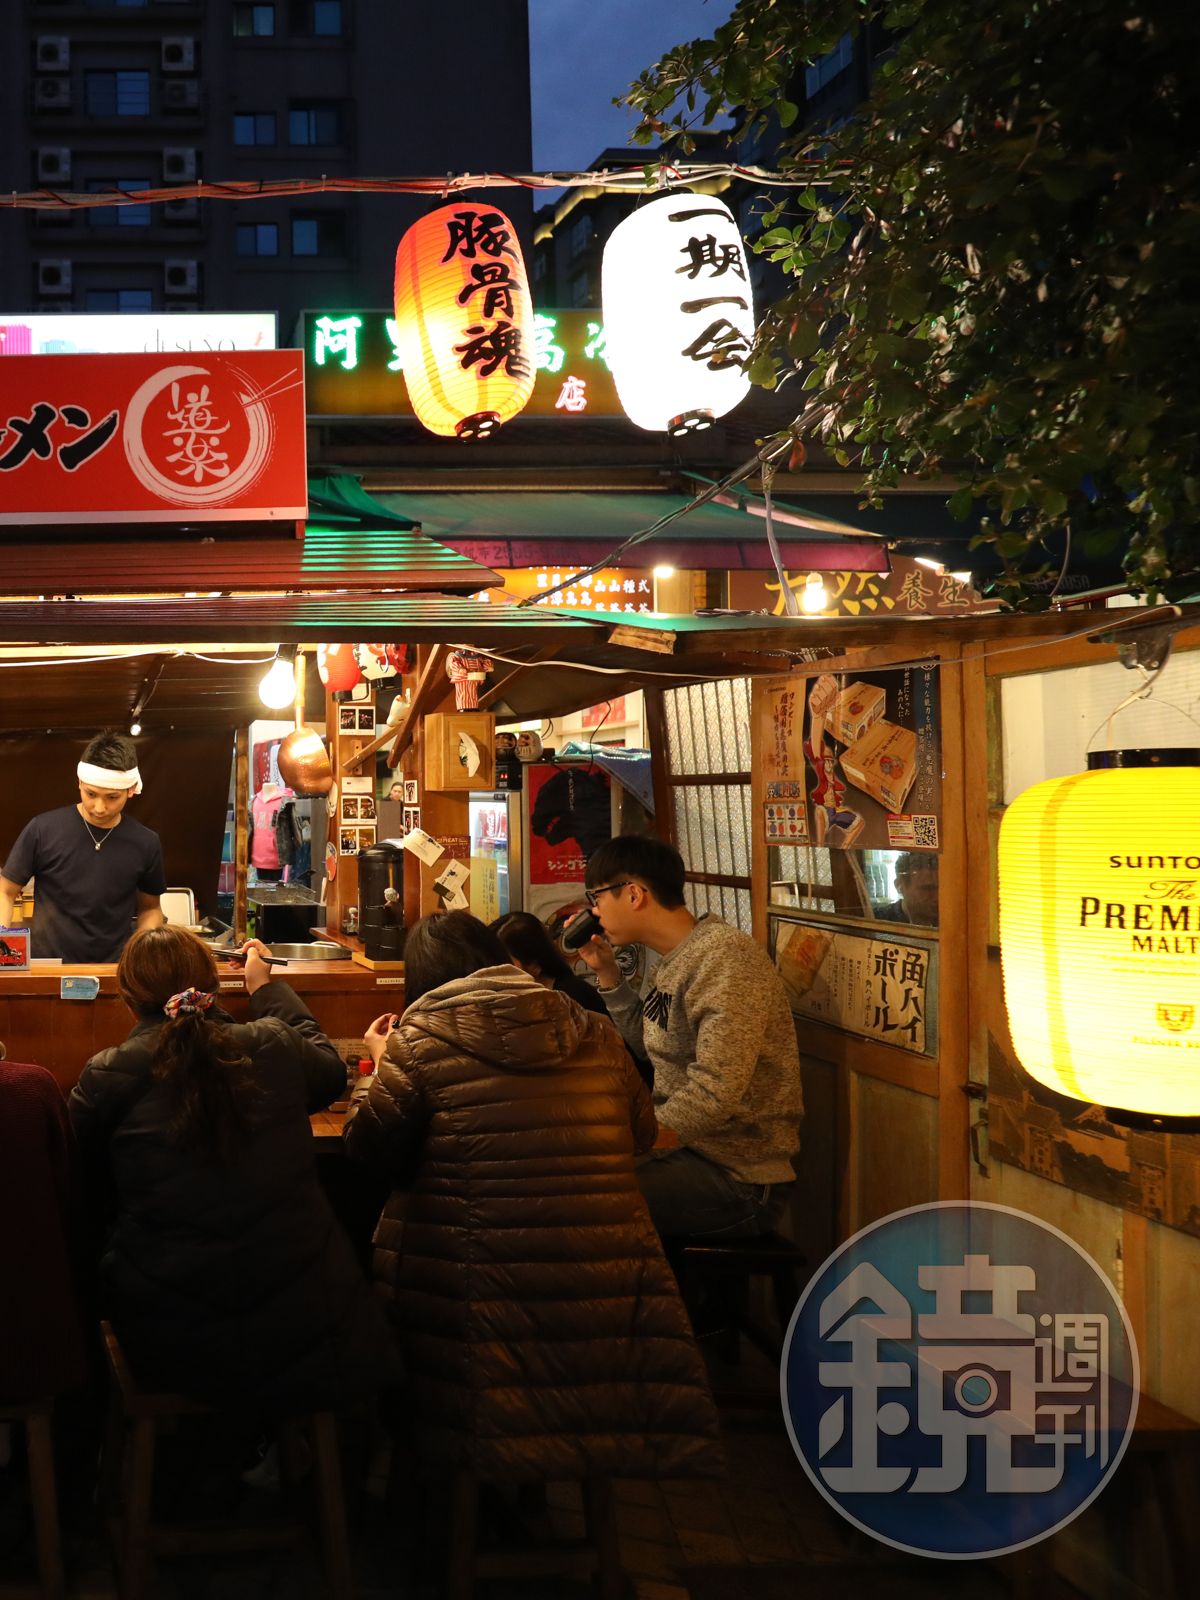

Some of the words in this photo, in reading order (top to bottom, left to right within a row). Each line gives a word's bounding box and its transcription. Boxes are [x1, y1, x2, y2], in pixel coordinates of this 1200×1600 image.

[441, 211, 528, 378] 豚骨魂
[667, 208, 753, 372] 一期一会
[556, 376, 587, 411] 店
[1080, 896, 1200, 932] PREM
[1144, 880, 1197, 900] The
[873, 948, 899, 1033] ボール
[899, 951, 925, 1043] 角ハイ
